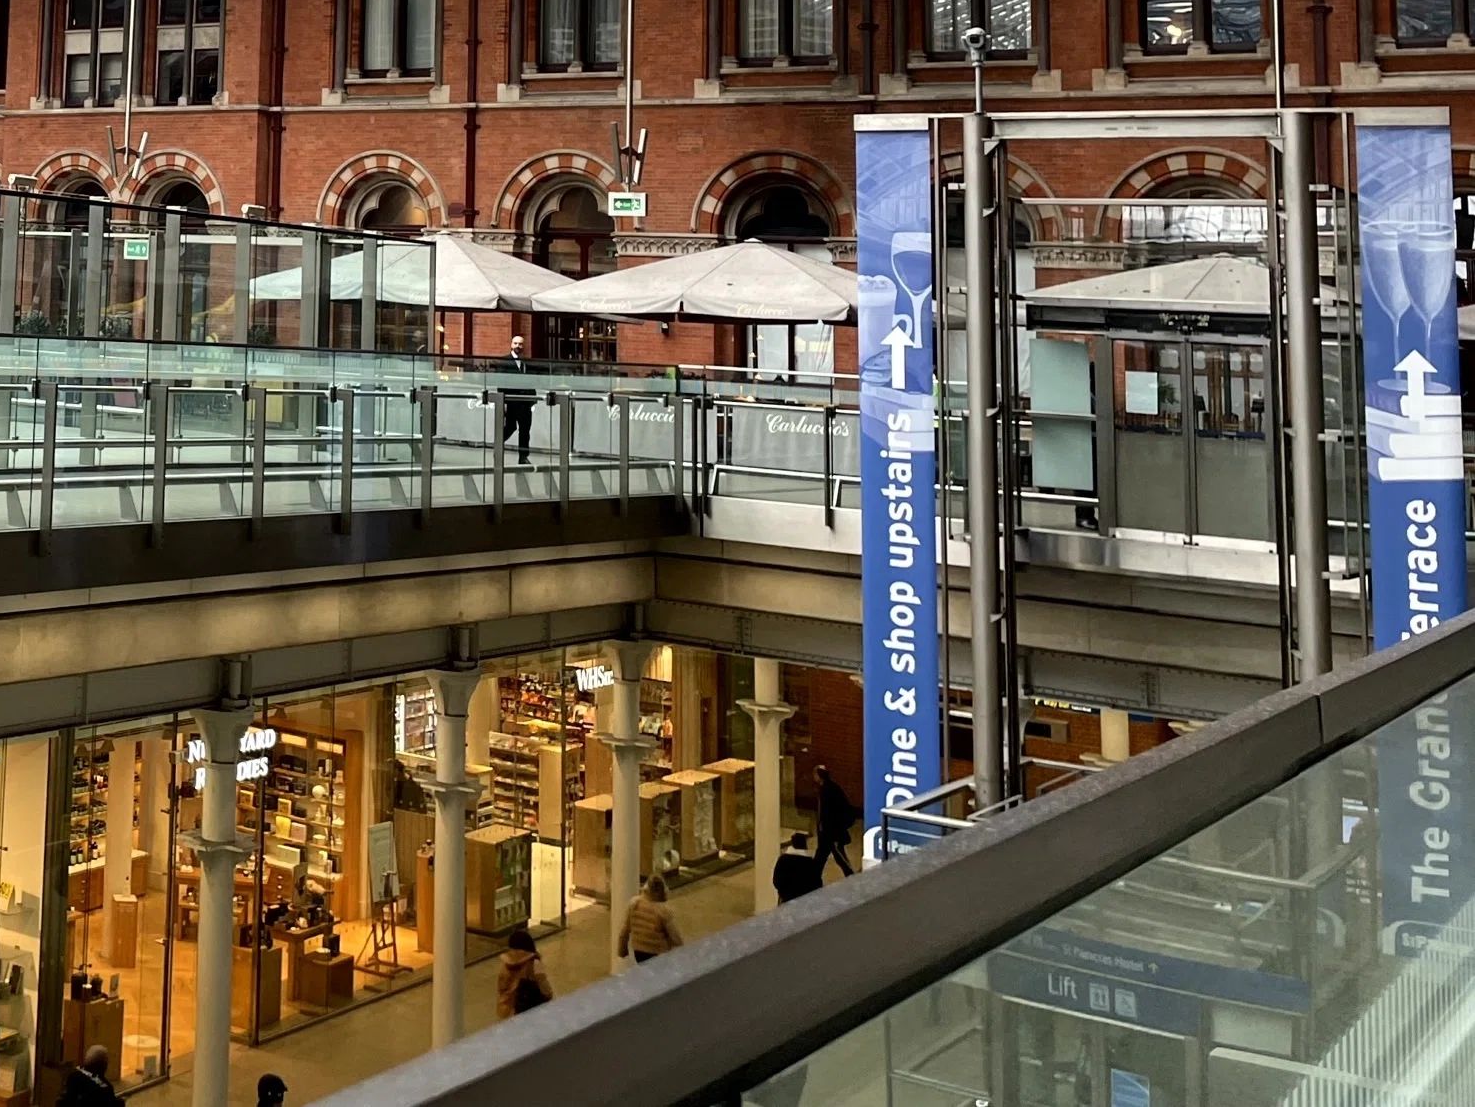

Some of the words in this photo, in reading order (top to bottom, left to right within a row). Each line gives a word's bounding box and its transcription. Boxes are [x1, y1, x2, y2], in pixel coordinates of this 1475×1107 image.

[880, 412, 922, 568] upstairs
[1401, 499, 1440, 642] errace
[882, 581, 922, 675] shop
[884, 686, 916, 716] &
[195, 756, 269, 791] RDIES
[239, 728, 277, 753] YARD
[884, 727, 918, 809] Dine
[1410, 826, 1450, 903] The
[1048, 973, 1078, 1000] Lift
